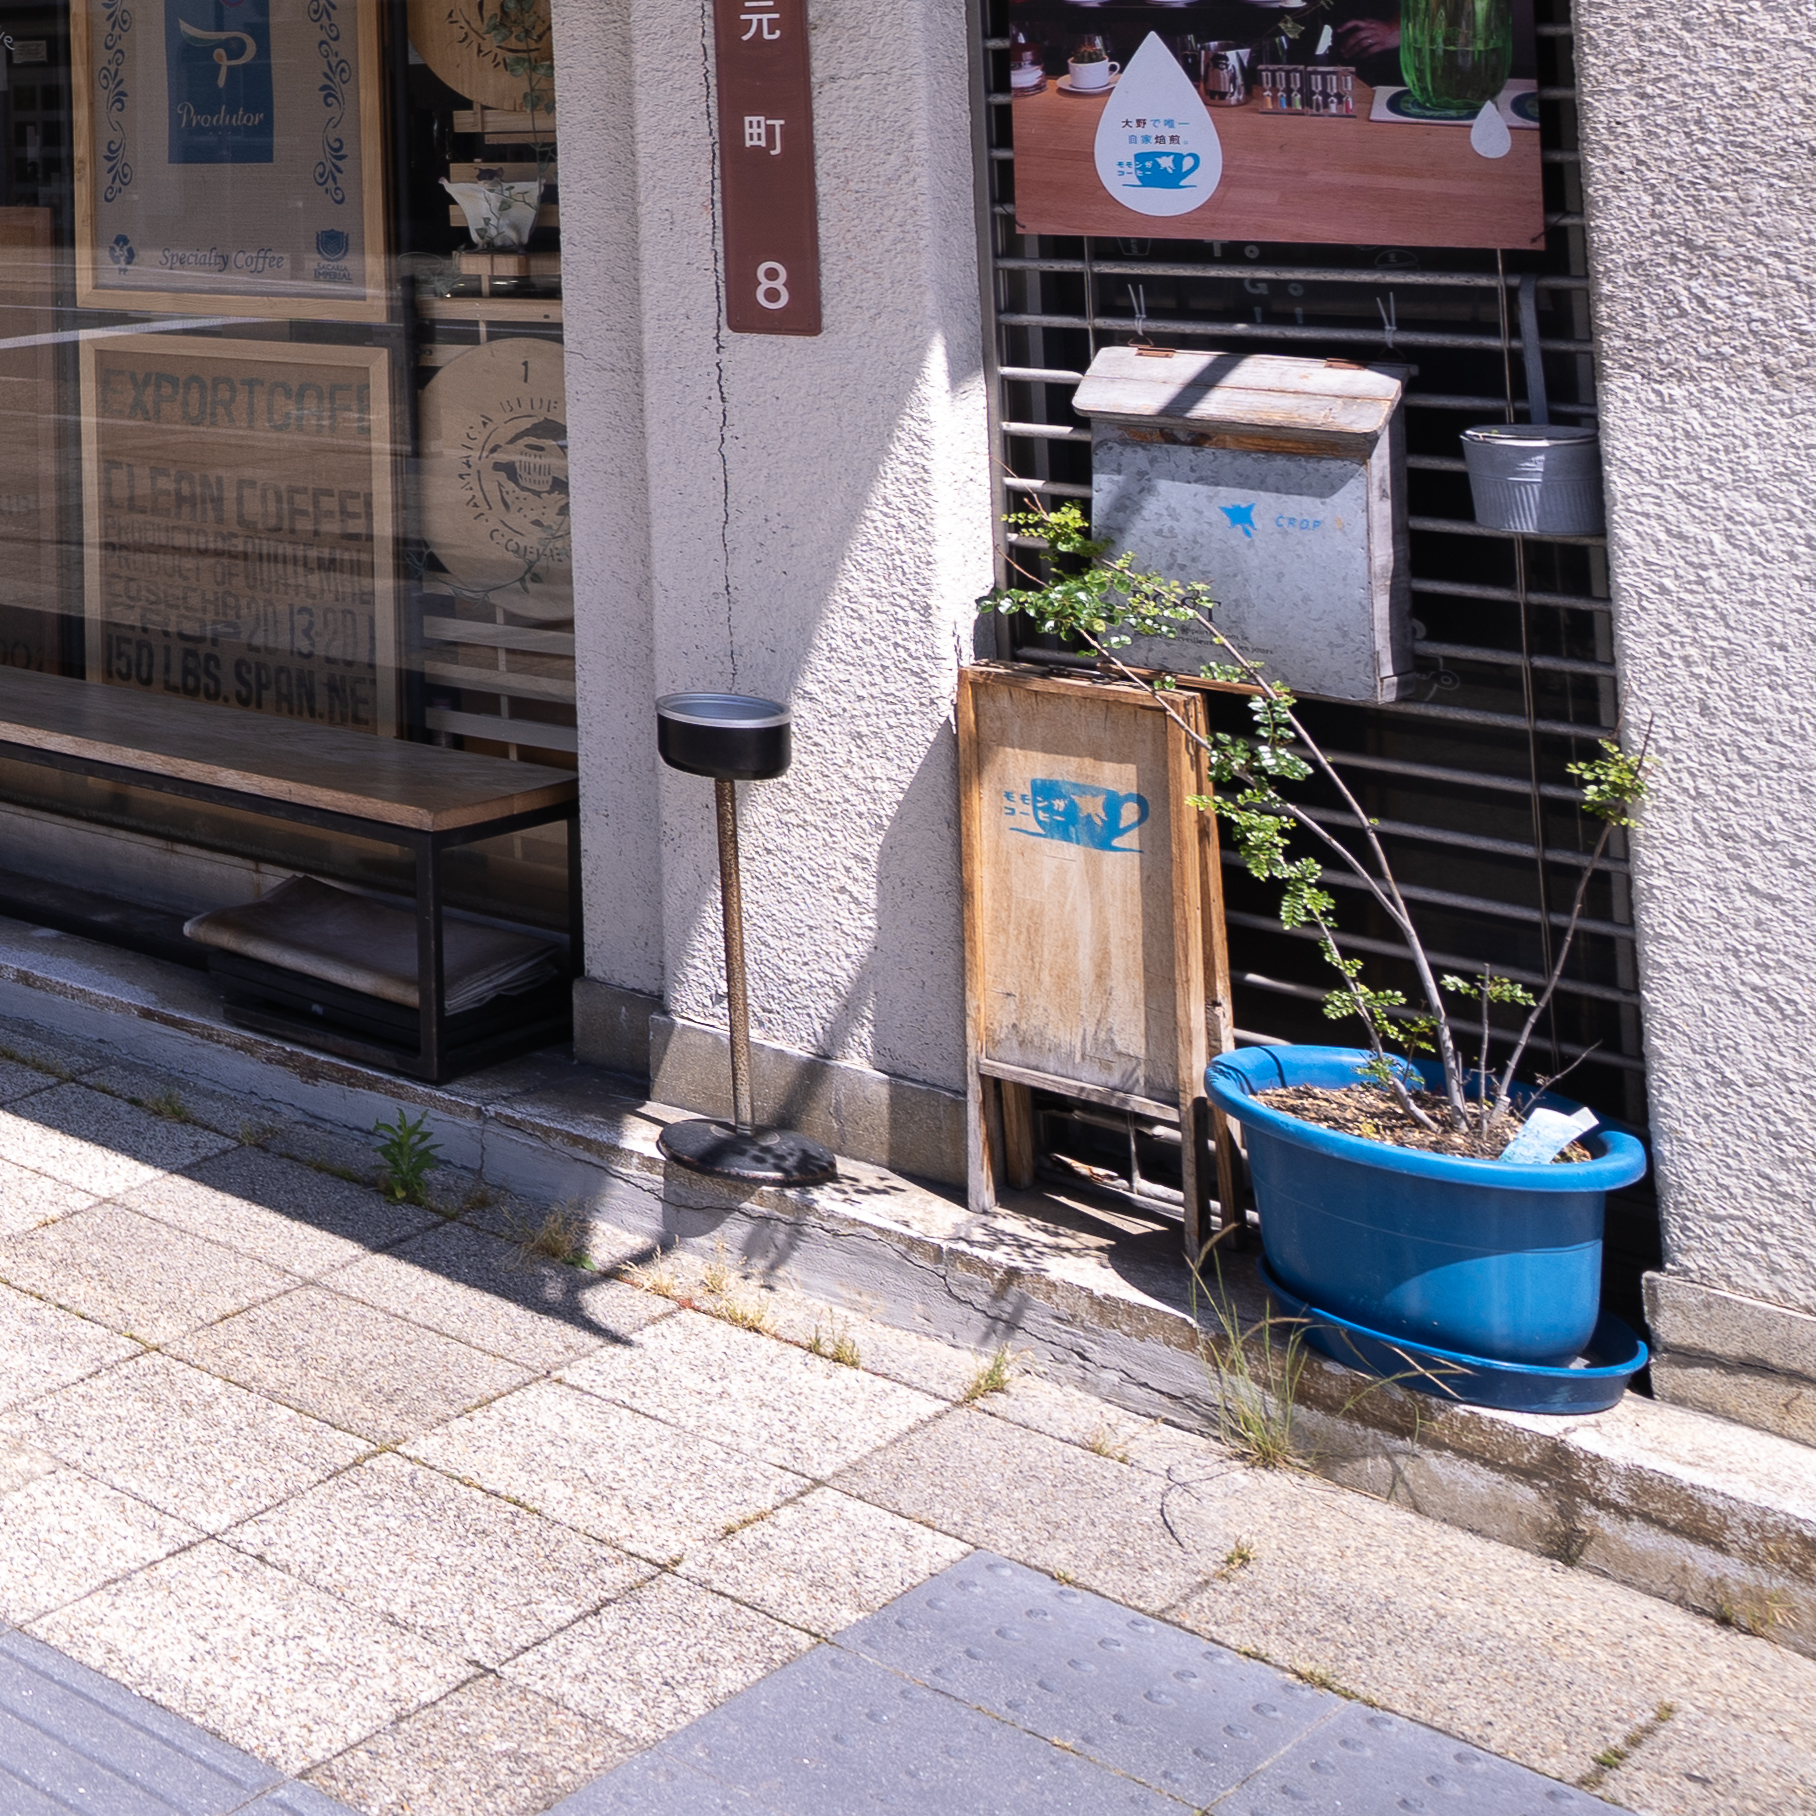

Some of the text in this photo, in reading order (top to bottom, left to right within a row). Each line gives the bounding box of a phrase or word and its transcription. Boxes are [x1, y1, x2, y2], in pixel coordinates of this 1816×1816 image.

[176, 101, 265, 128] Produtor
[1121, 118, 1190, 129] 大野で唯一
[159, 247, 285, 274] Specialty Coffee
[103, 458, 225, 525] CLEAN
[1275, 515, 1322, 531] CROP
[105, 632, 155, 687] 150
[1003, 790, 1068, 812] モモンガ
[1003, 805, 1066, 822] コーヒー
